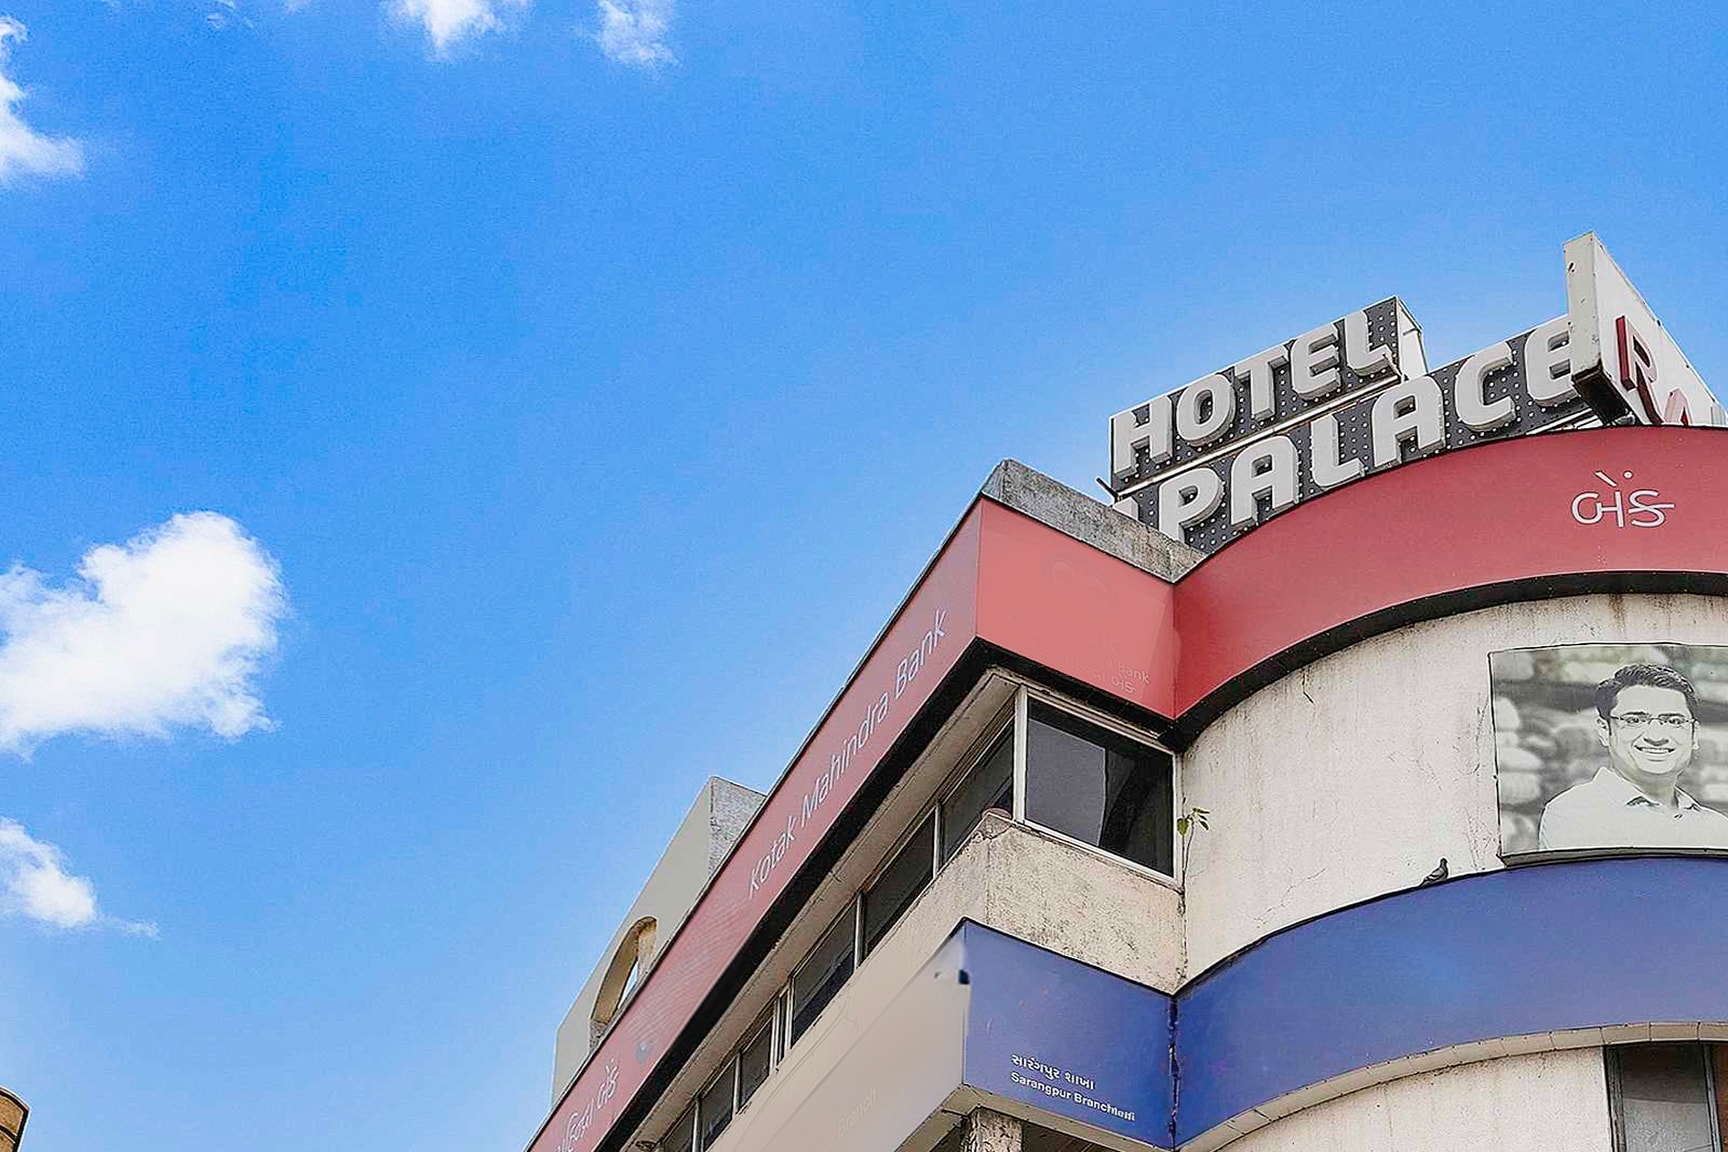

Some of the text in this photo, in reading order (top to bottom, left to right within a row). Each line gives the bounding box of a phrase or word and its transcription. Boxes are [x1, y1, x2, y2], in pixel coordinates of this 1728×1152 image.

[1112, 308, 1399, 479] HOTEL
[1157, 318, 1576, 543] PALACE
[1571, 471, 1674, 529] બેંક
[749, 609, 949, 897] Kotak Mahindra Bank
